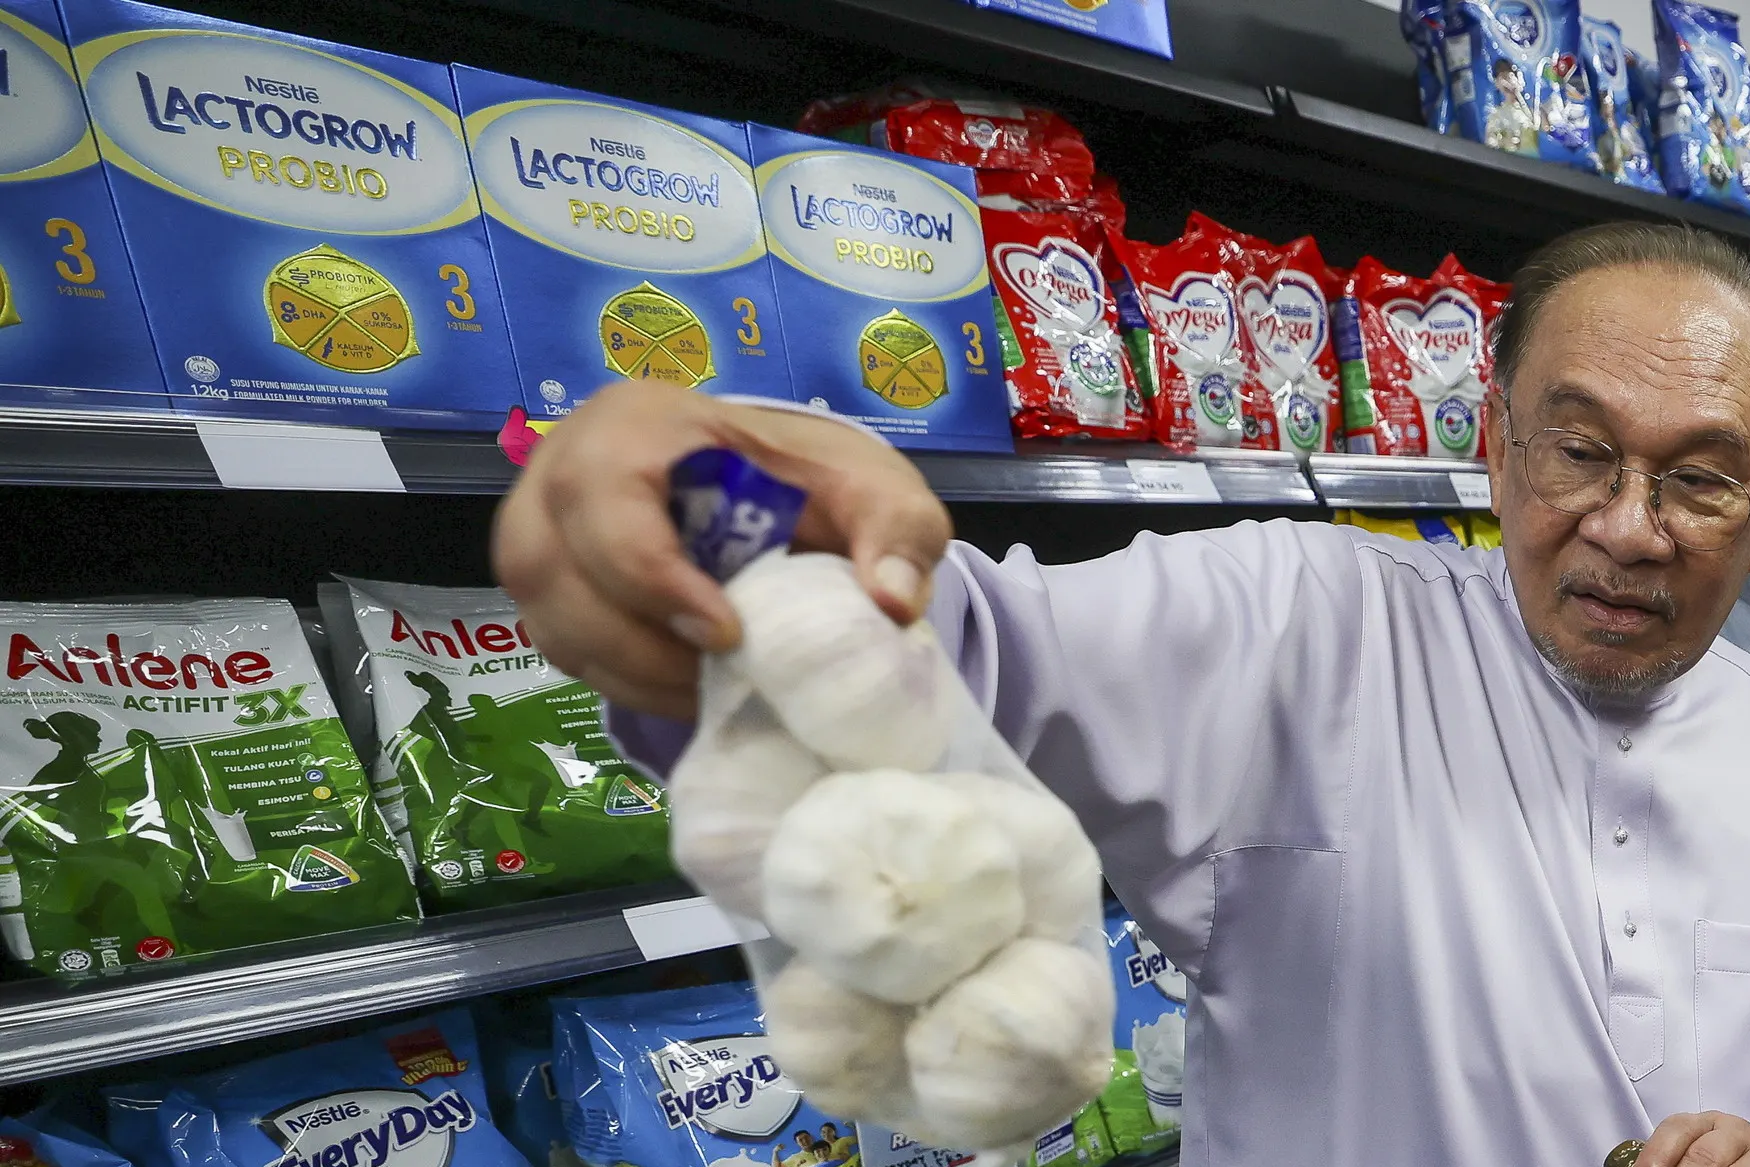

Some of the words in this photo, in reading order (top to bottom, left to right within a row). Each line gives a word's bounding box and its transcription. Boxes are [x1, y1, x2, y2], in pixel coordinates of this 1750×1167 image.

[136, 71, 418, 160] LACTOGROW
[217, 145, 388, 200] PROBIO
[510, 136, 720, 208] LACTOGROW
[568, 199, 696, 243] PROBIO
[790, 184, 953, 244] LACTOGROW
[45, 218, 96, 284] 3
[834, 236, 934, 274] PROBIO
[310, 269, 376, 286] PROBIOTIK
[438, 264, 476, 320] 3
[303, 309, 327, 320] DHA
[371, 311, 392, 322] 0%
[732, 297, 761, 346] 3
[962, 321, 985, 366] 3
[230, 379, 251, 388] SUSU
[252, 380, 280, 390] TEPUNG
[280, 382, 315, 392] RUMUSAN
[316, 384, 339, 394] UNTUK
[391, 609, 532, 660] Anle
[7, 633, 274, 690] Anlene
[122, 694, 229, 714] ACTIFIT
[233, 683, 312, 728] 3X
[211, 748, 240, 757] Kekal
[242, 745, 269, 756] Aktif
[271, 741, 293, 751] Hari
[224, 762, 266, 773] TULANG
[268, 758, 296, 769] KUAT
[228, 779, 277, 790] MEMBINA
[279, 775, 302, 786] TISU
[270, 829, 303, 839] PERISA
[305, 866, 329, 875] MOVE
[659, 1054, 781, 1126] EveryD
